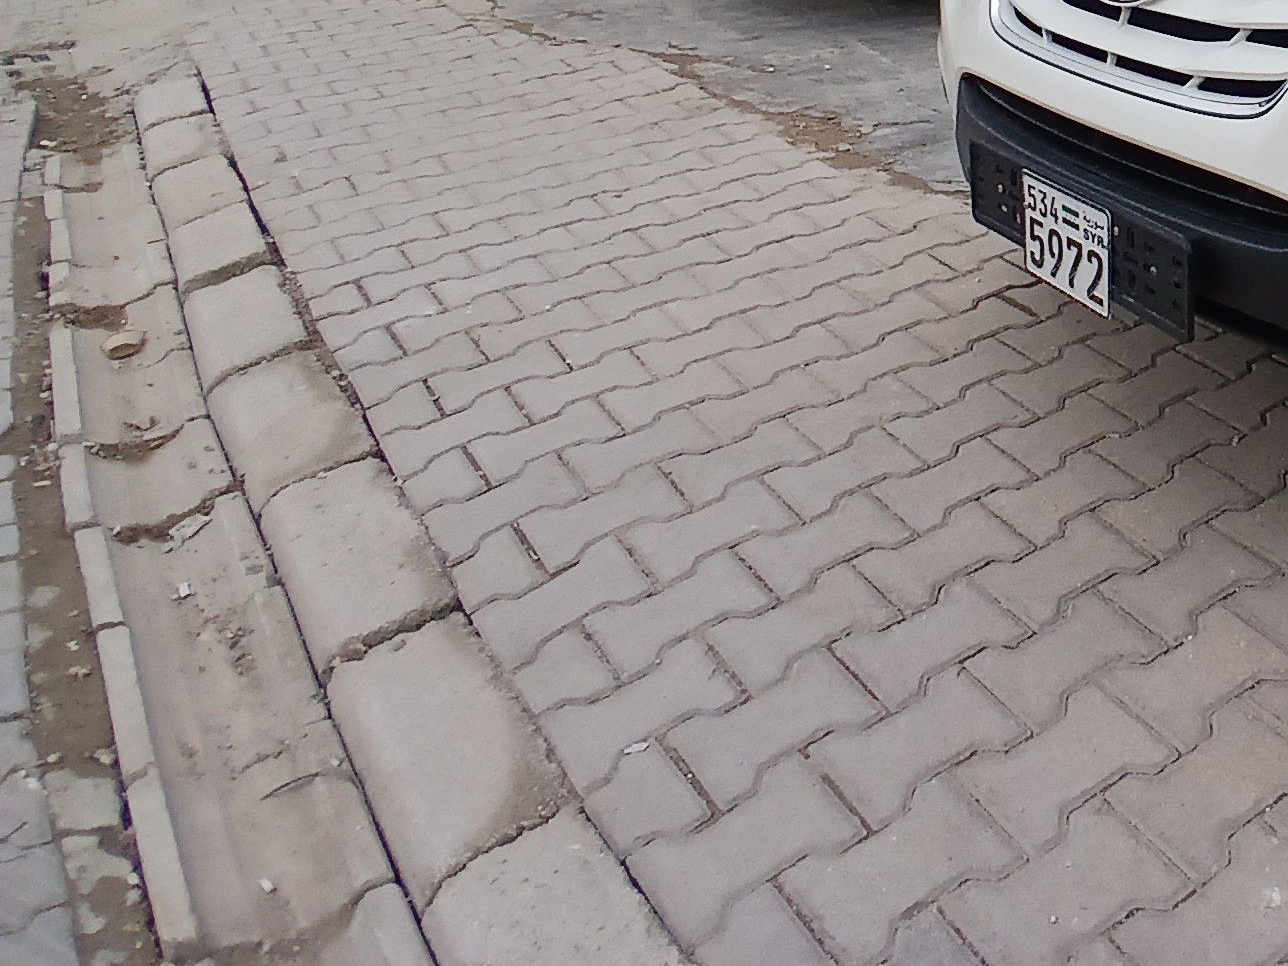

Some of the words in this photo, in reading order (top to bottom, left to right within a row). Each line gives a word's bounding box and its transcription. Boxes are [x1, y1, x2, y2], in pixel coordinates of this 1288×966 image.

[1027, 184, 1059, 224] 534
[1083, 228, 1106, 248] SYR
[1029, 216, 1104, 307] 5972
